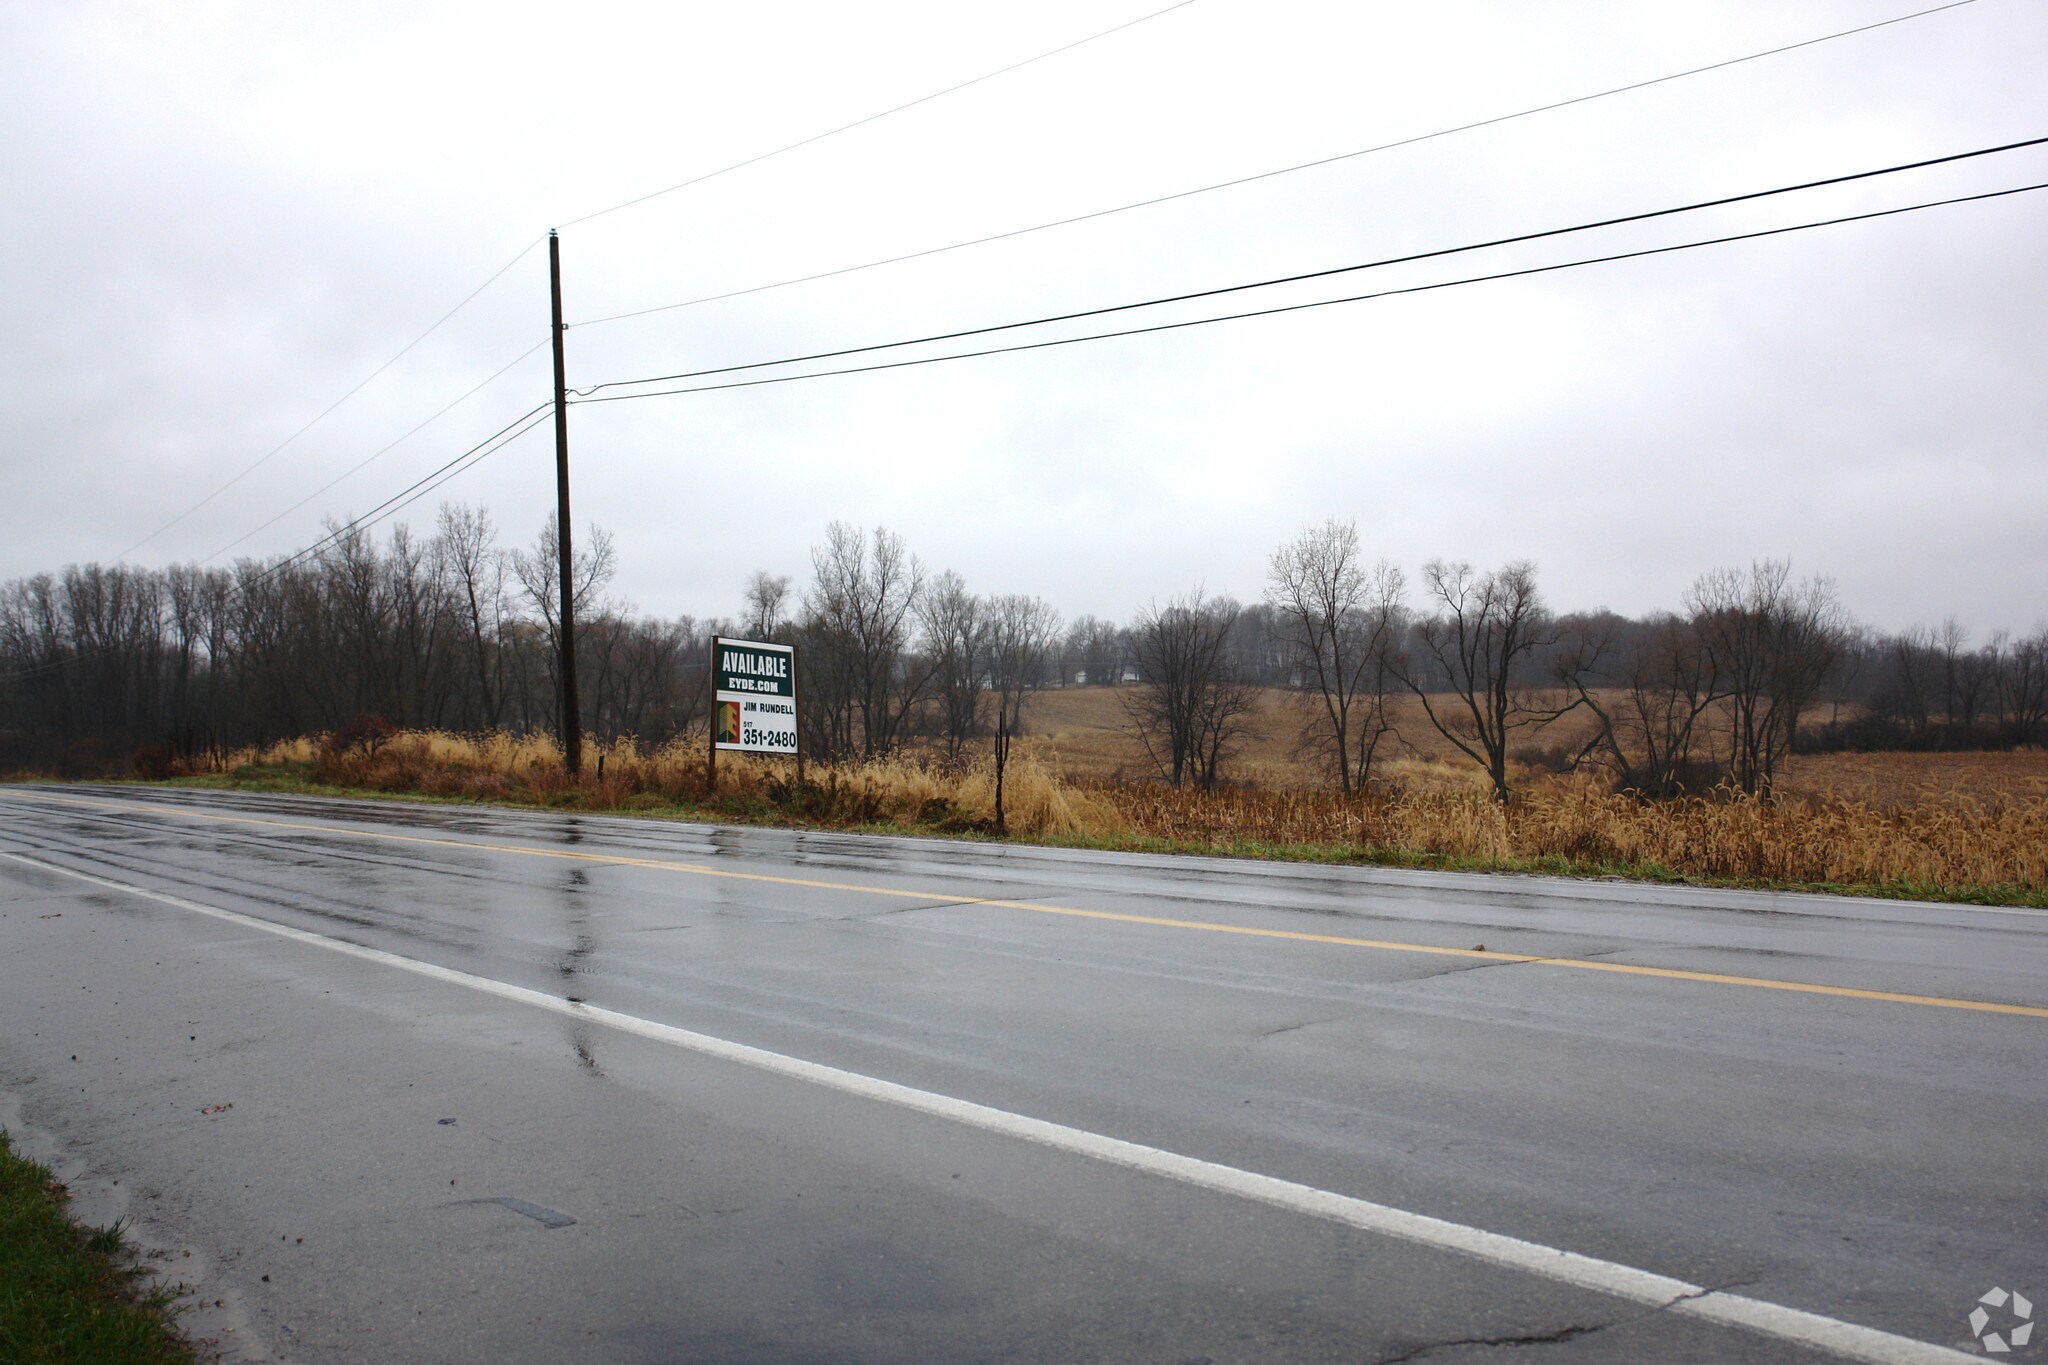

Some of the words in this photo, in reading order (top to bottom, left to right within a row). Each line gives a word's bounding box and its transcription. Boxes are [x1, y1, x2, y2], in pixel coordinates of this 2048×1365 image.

[722, 651, 787, 678] AVAILABLE
[728, 677, 779, 693] EYDE.COM
[743, 702, 757, 712] JIM
[760, 703, 794, 715] RUNDELL
[743, 720, 753, 728] 517
[743, 728, 796, 748] 351-2480
